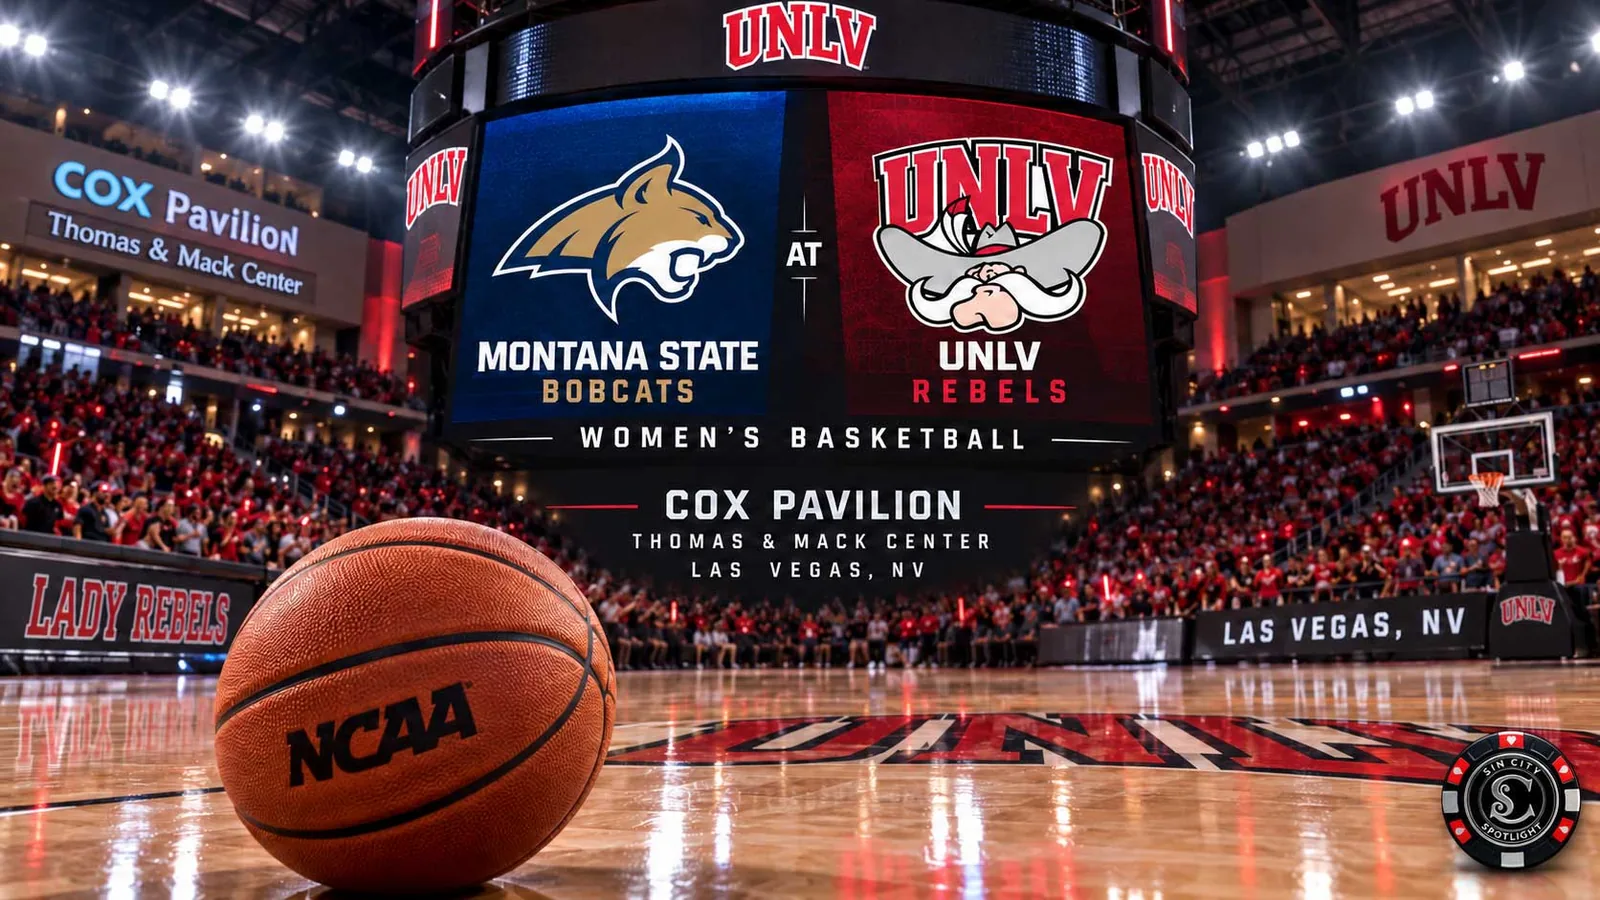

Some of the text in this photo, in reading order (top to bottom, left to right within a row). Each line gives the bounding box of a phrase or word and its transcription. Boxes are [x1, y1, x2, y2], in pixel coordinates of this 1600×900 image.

[723, 1, 877, 71] UNLV
[53, 161, 154, 218] COX
[406, 147, 468, 231] UNLV
[874, 138, 1113, 240] UNLV
[1141, 153, 1195, 239] UNLV
[1380, 152, 1545, 243] UNLV
[48, 211, 303, 295] Thomas & Mack Center
[786, 242, 822, 267] AT
[477, 341, 759, 372] MONTANA STATE
[939, 341, 1041, 371] UNLV
[542, 379, 694, 403] BOBCATS
[913, 379, 1067, 403] REBELS
[580, 426, 1024, 450] WOMEN'S BASKETBALL
[665, 489, 961, 520] COX PAVILION
[632, 533, 990, 550] THOMAS & MACK CENTER
[691, 562, 924, 581] LAS VEGAS, NV
[24, 572, 231, 646] LADY REBELS
[1223, 607, 1465, 645] LAS VEGAS, NV
[1500, 594, 1556, 626] UNLV
[286, 682, 478, 788] NCAA
